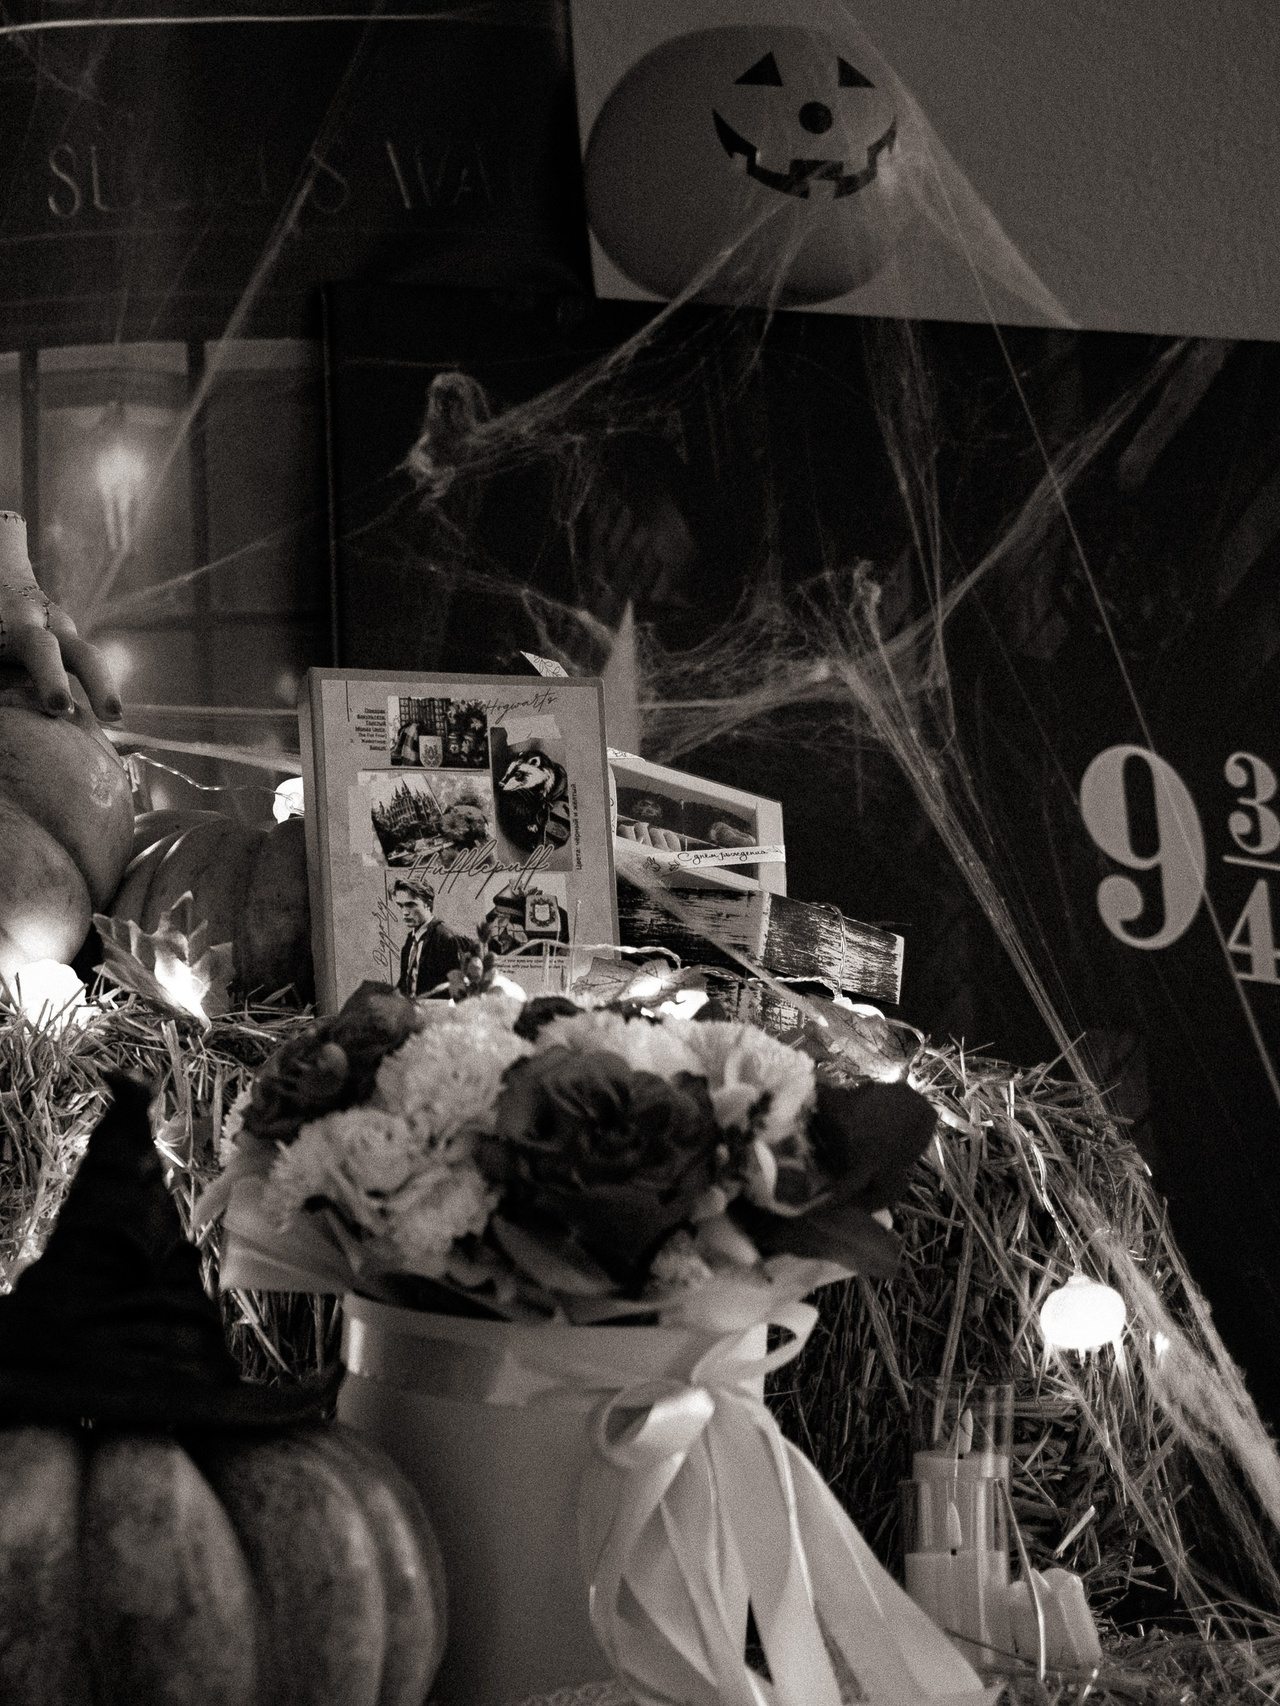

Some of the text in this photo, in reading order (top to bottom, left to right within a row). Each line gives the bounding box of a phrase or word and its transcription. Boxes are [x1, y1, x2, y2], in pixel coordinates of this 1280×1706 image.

[482, 687, 558, 725] Hogwarts
[407, 839, 554, 900] Hufflepuff
[1080, 743, 1206, 950] 9
[372, 896, 400, 967] Diggory
